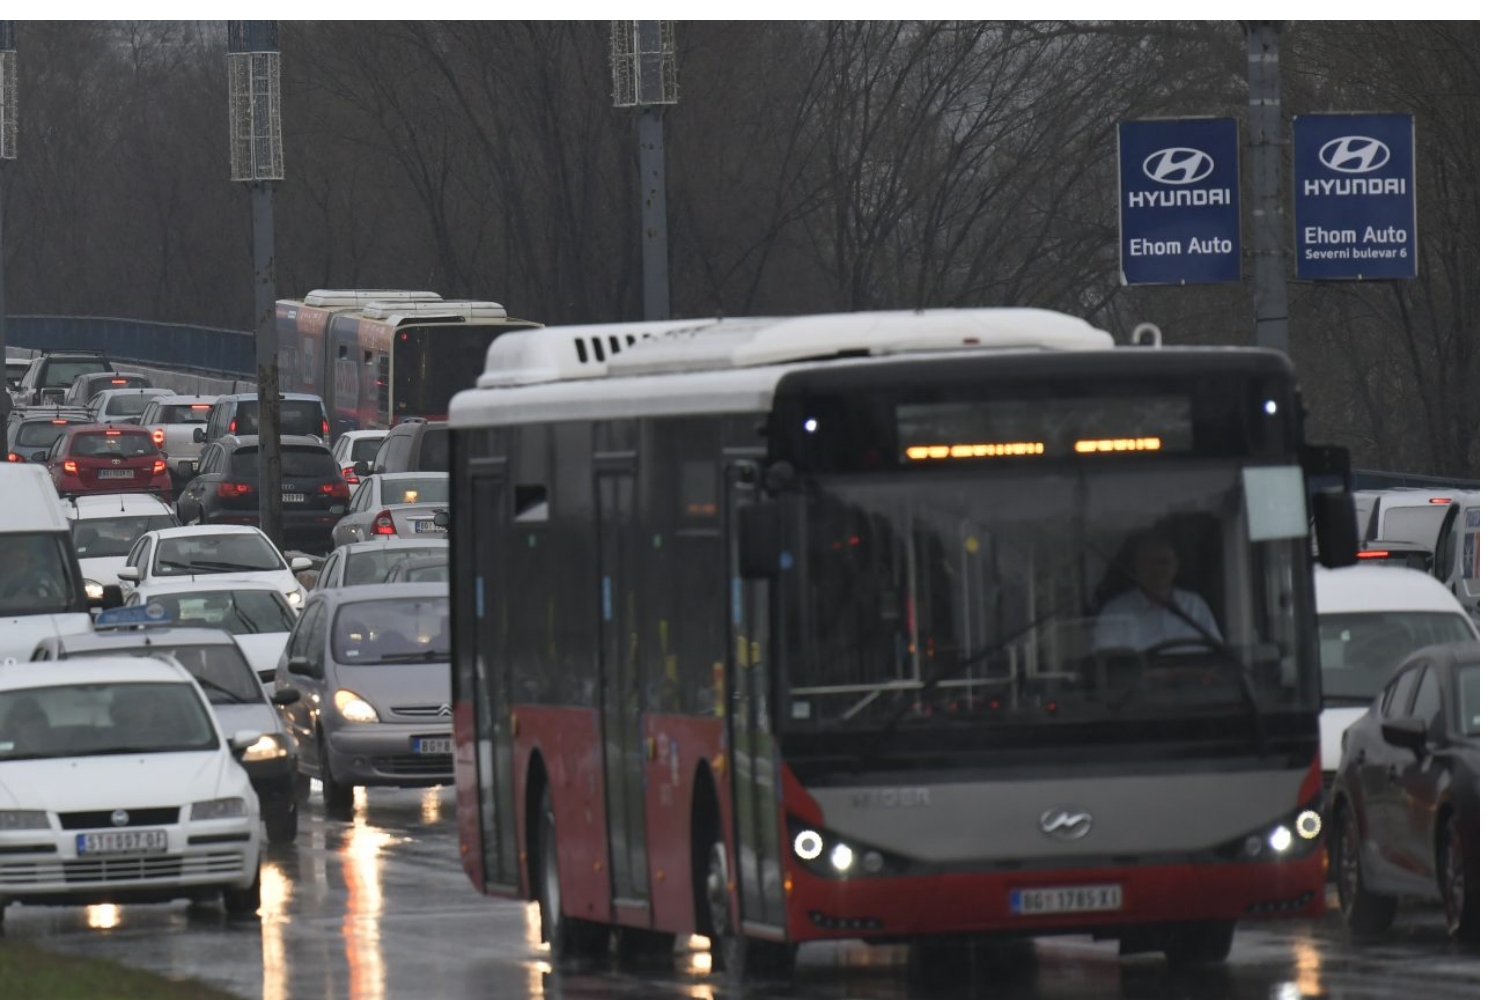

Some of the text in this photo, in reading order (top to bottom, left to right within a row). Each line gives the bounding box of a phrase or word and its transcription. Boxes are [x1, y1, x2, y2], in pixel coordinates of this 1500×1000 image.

[1304, 178, 1406, 196] HYUNDAI
[1129, 188, 1231, 207] HYUNDAI
[1305, 225, 1408, 244] Ehom Auto
[1130, 237, 1232, 256] Ehom Auto
[1305, 247, 1408, 260] Severni bulevar 6
[1023, 888, 1044, 910] BG
